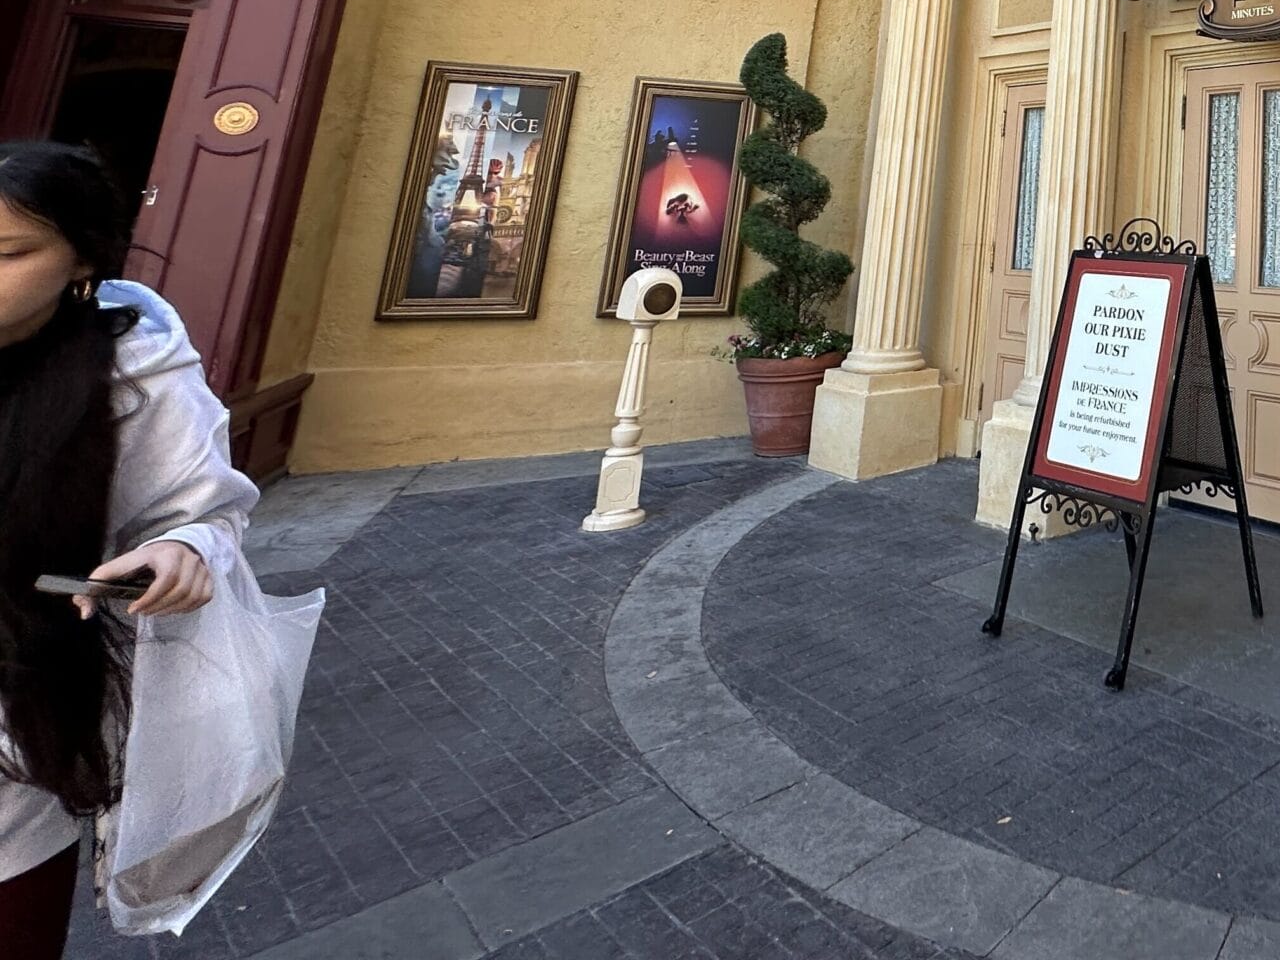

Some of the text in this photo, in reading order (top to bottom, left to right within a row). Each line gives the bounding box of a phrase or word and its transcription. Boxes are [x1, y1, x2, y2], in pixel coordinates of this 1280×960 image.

[1231, 5, 1274, 20] MINUTES
[446, 113, 539, 133] FRANCE
[634, 249, 675, 264] Beauty
[685, 250, 715, 262] Beast
[671, 262, 706, 277] Along
[1093, 305, 1144, 321] PARDON
[1084, 322, 1146, 341] OUR PIXIE
[1095, 342, 1129, 358] DUST
[1072, 380, 1138, 401] IMPRESSIONS
[1088, 397, 1127, 414] FRANCE
[1059, 420, 1067, 428] for
[1068, 423, 1082, 431] your
[1083, 425, 1101, 435] future
[1070, 410, 1130, 429] is being refurbished
